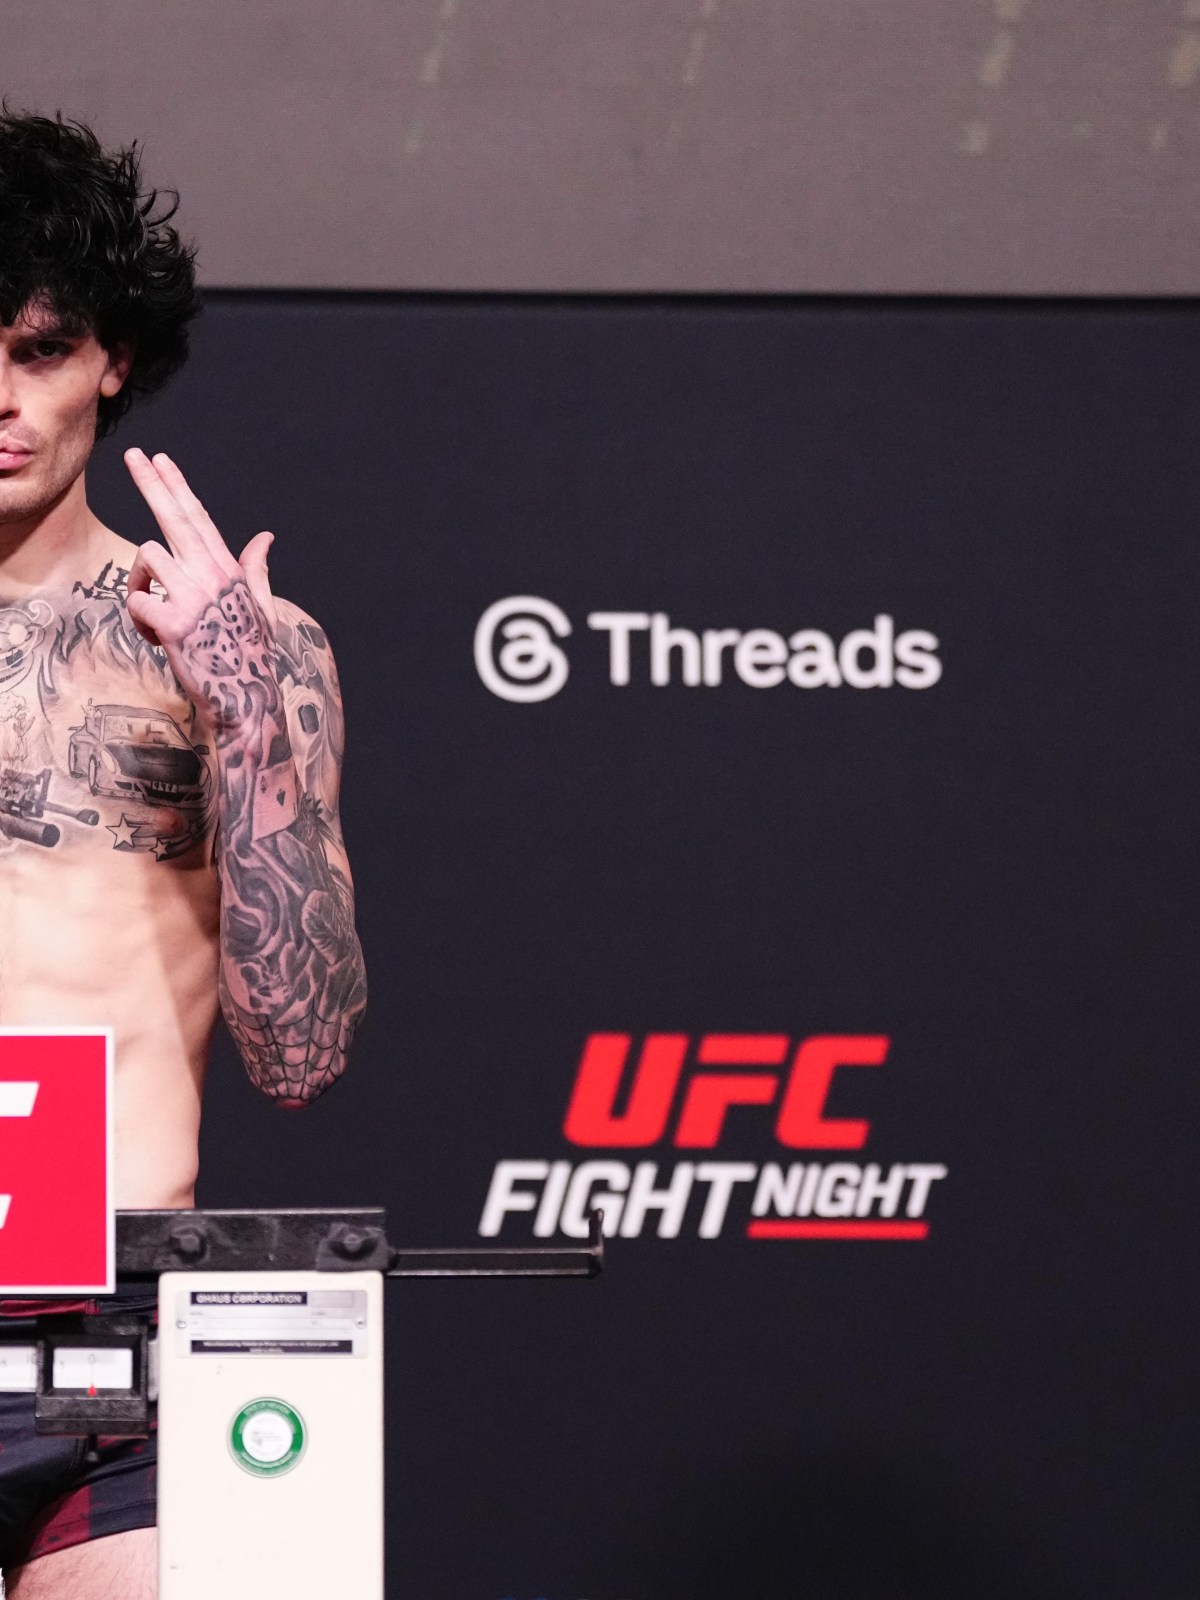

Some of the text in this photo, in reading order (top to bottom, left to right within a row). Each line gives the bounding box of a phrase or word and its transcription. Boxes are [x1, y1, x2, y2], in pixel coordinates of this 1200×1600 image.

[587, 612, 942, 689] Threads
[562, 1033, 890, 1150] UFC
[479, 1160, 948, 1240] FIGHT NIGHT
[232, 1293, 303, 1304] CORPORATION
[87, 1353, 96, 1365] 0
